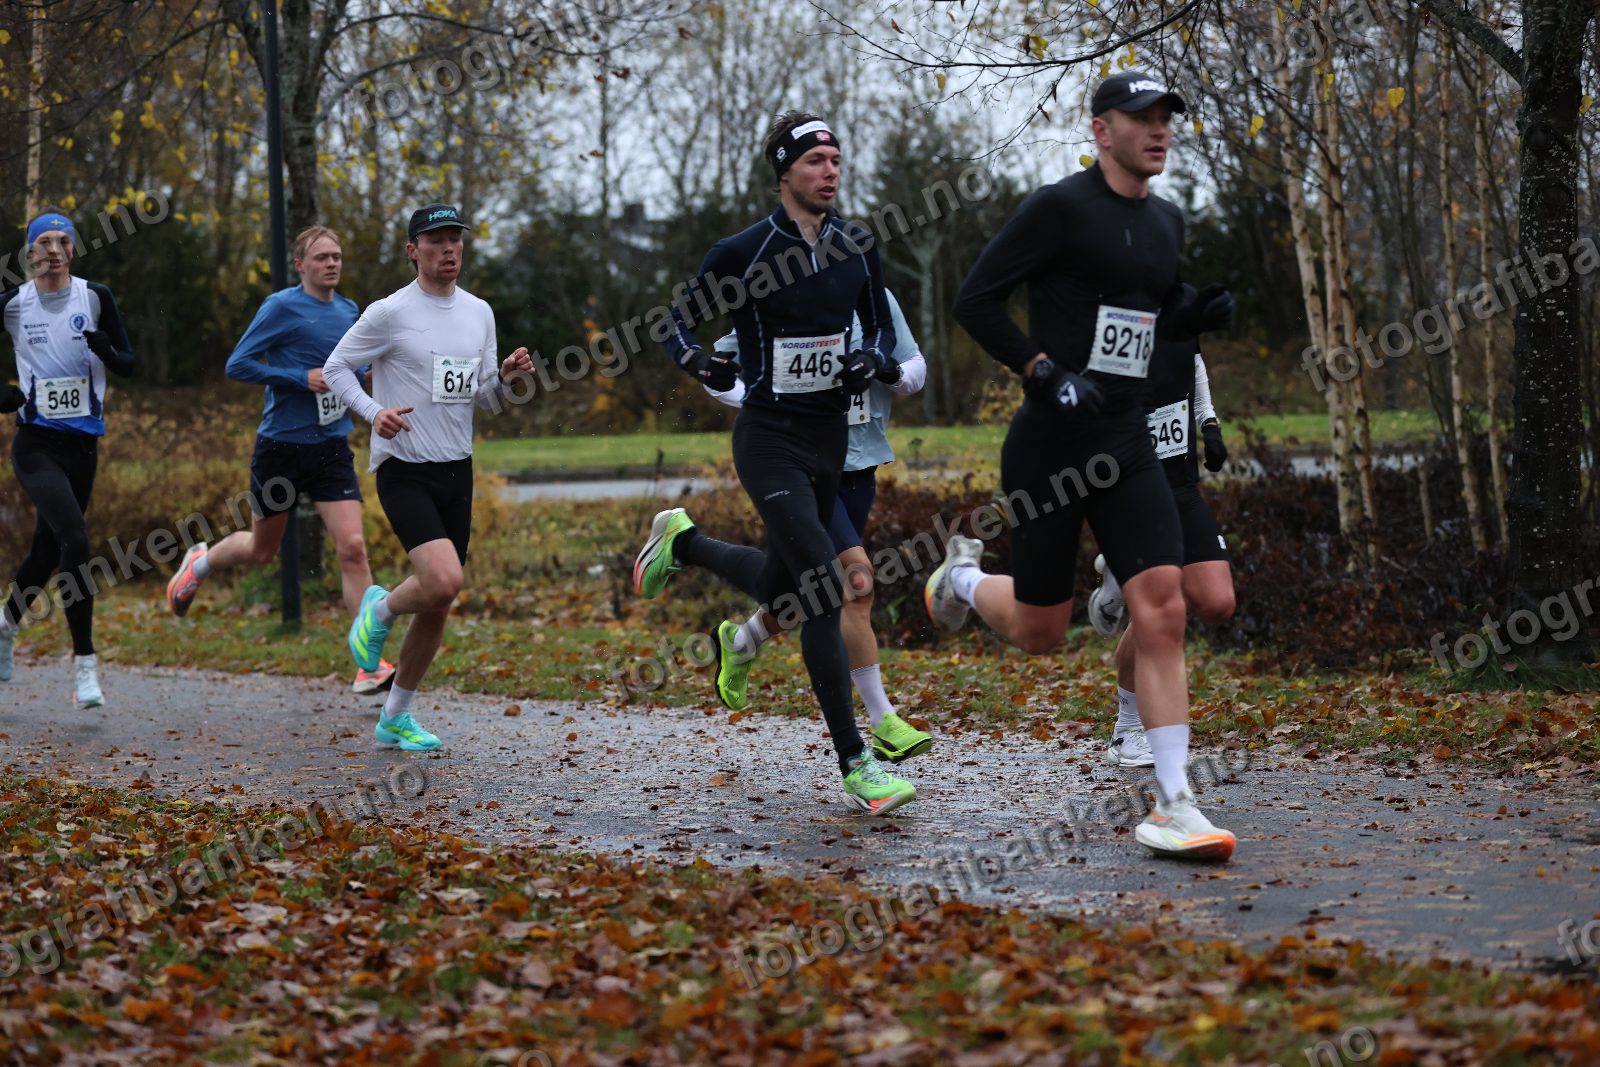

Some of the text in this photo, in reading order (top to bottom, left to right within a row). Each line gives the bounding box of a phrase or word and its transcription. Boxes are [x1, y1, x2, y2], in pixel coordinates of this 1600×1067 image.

[428, 210, 458, 222] HOKA
[1101, 324, 1151, 361] 9218
[788, 350, 833, 380] 446
[444, 370, 474, 393] 614
[48, 388, 80, 410] 548
